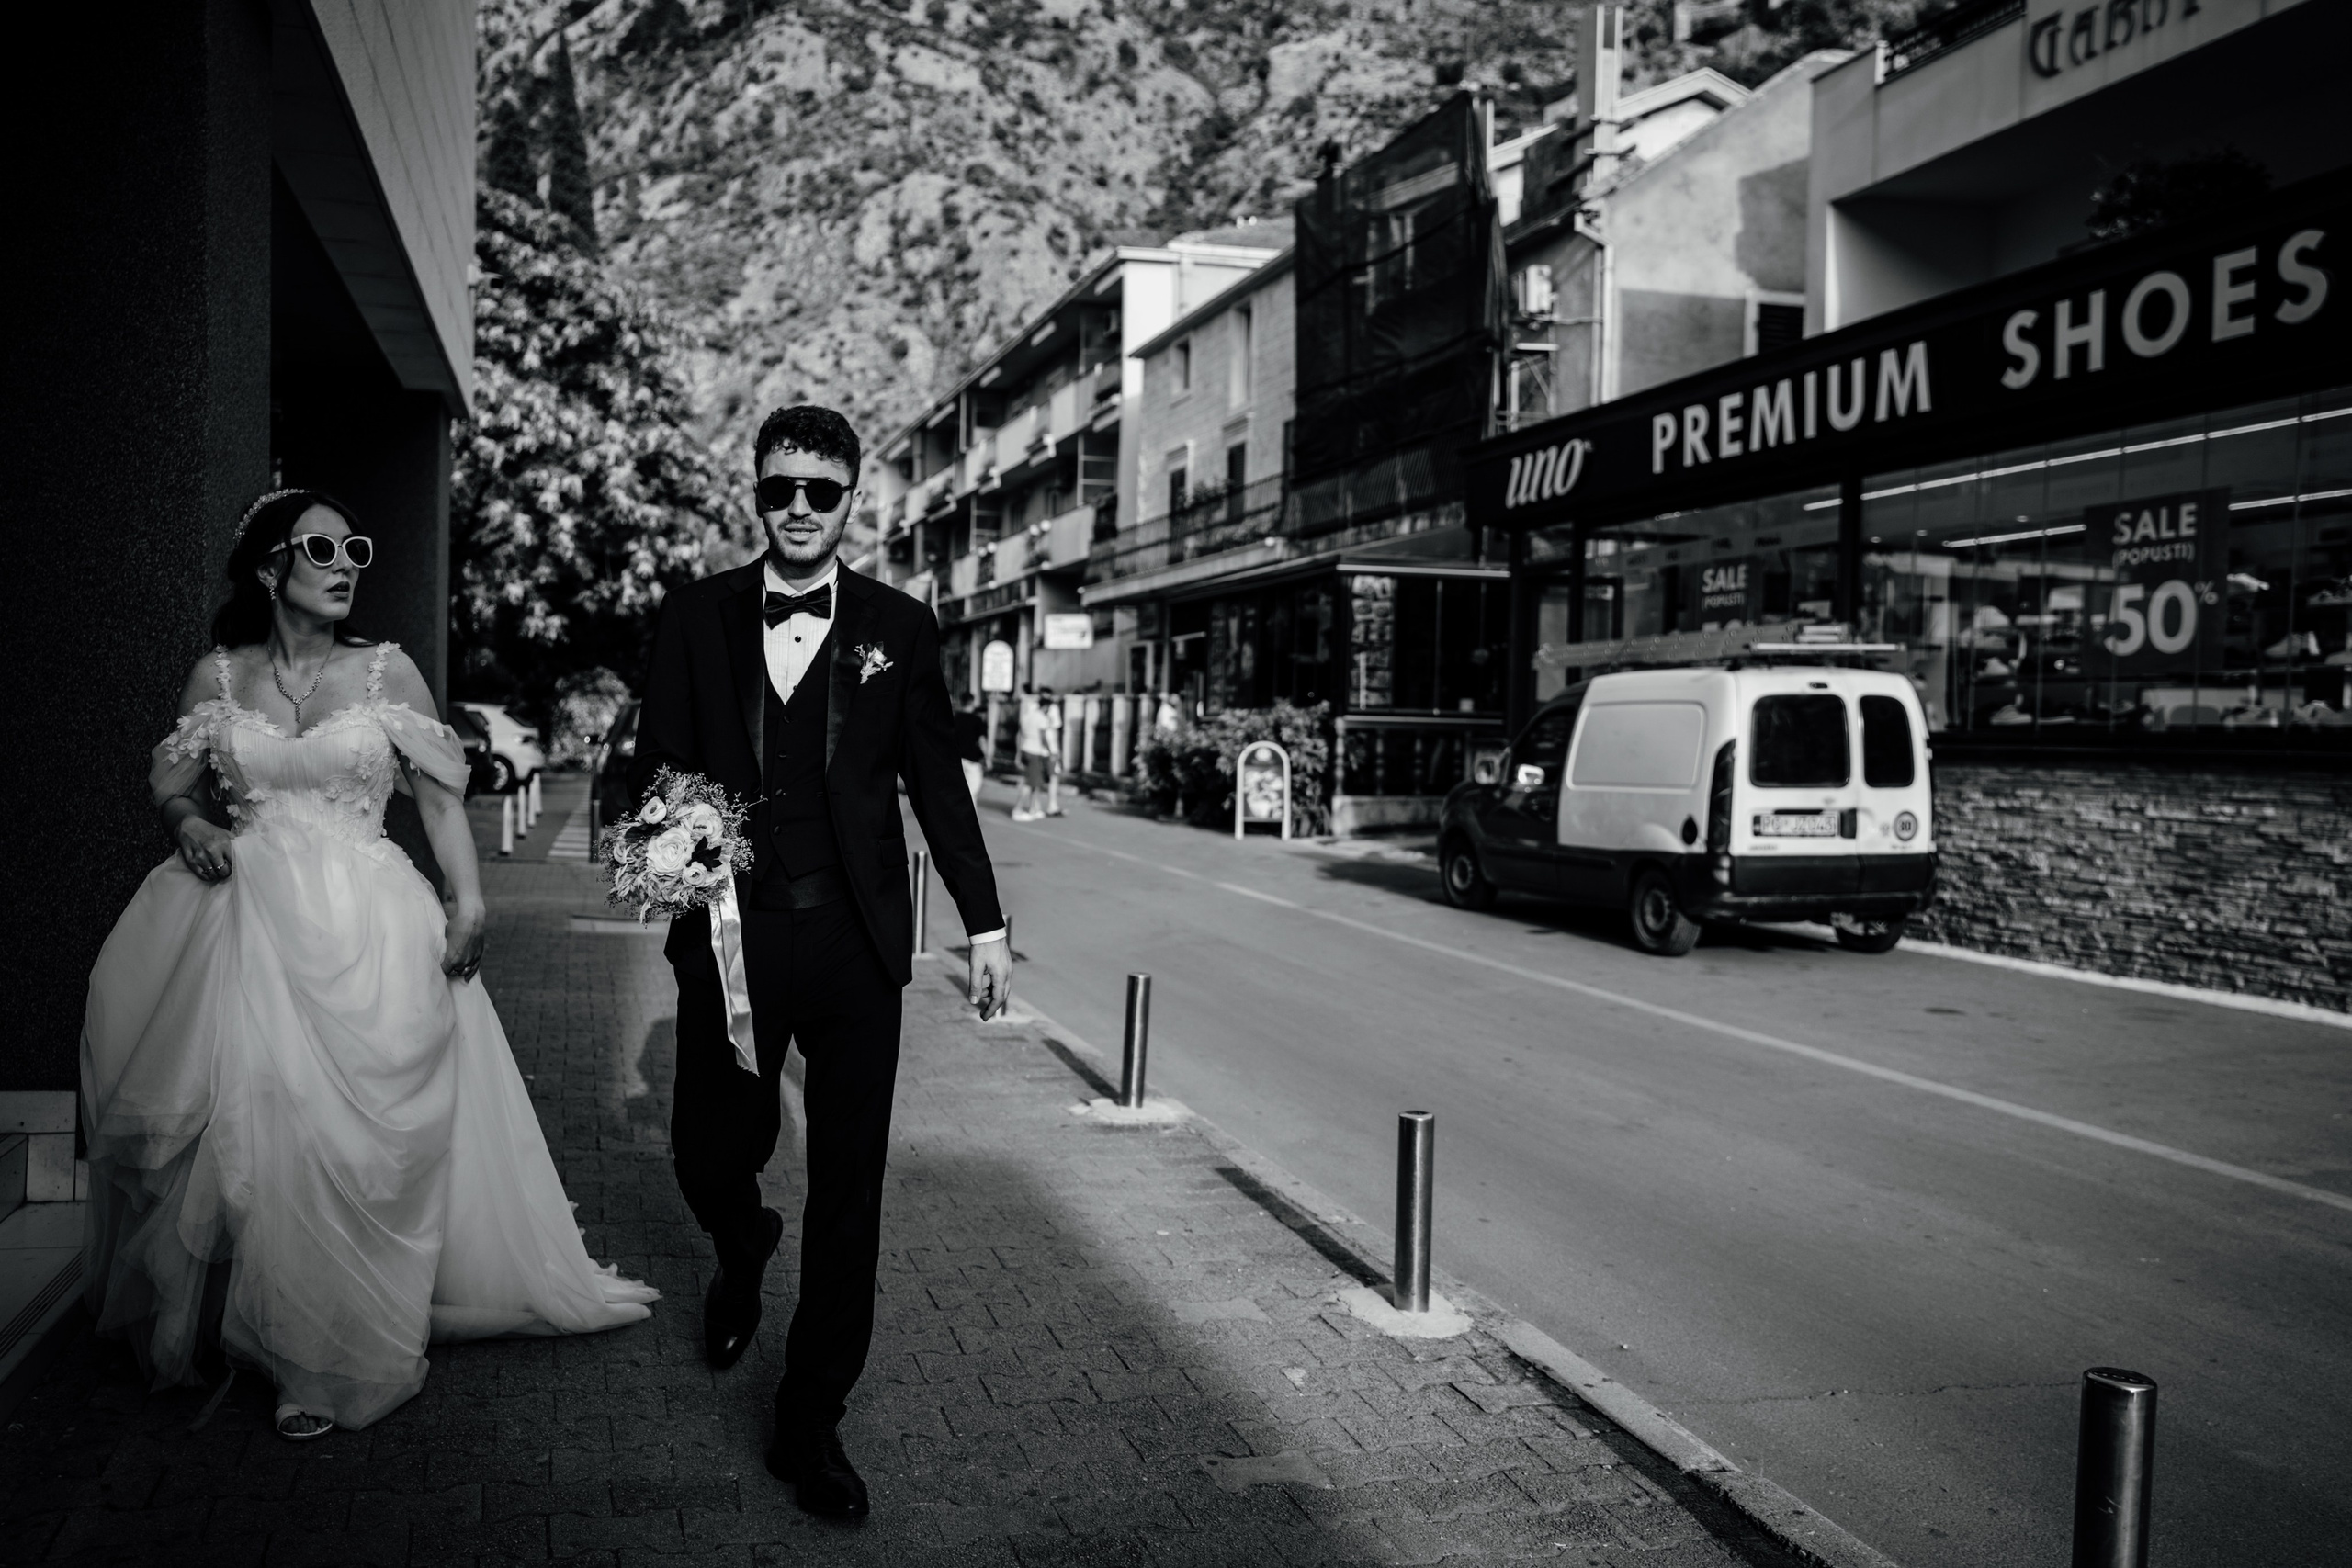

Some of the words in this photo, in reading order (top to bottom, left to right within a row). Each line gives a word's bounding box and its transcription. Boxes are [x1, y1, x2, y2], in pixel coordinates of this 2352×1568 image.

[1653, 340, 1931, 474] PREMIUM
[2000, 229, 2329, 390] SHOES
[2112, 503, 2197, 545] SALE
[1701, 563, 1747, 594] SALE
